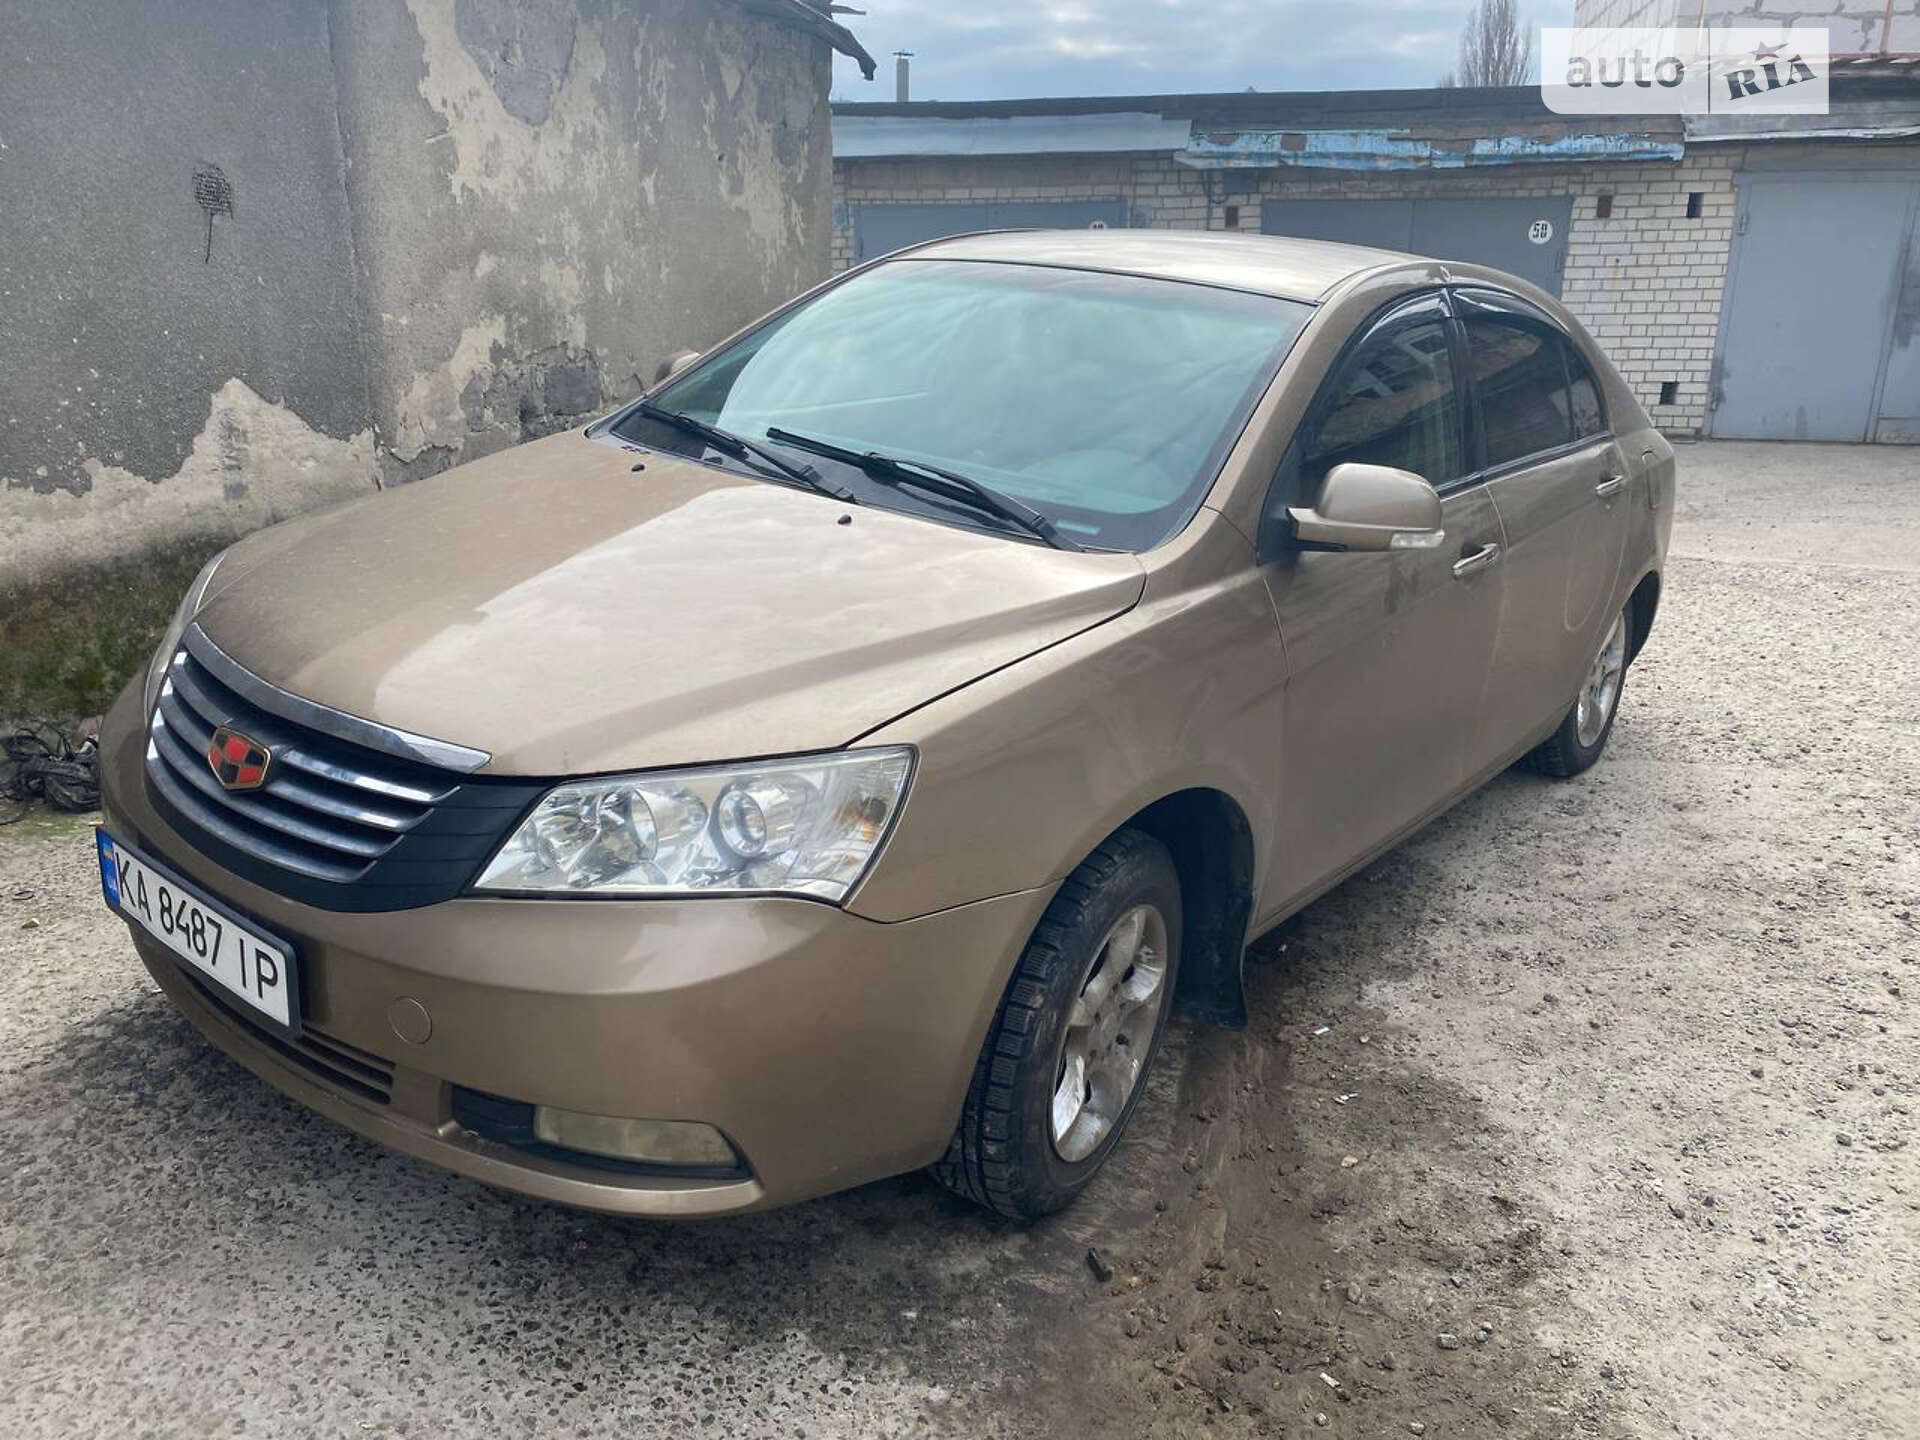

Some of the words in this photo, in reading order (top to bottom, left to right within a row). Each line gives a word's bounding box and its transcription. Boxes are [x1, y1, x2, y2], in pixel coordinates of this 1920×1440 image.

[116, 852, 152, 923] KA
[158, 886, 223, 967] 8487
[239, 937, 279, 1000] IP
